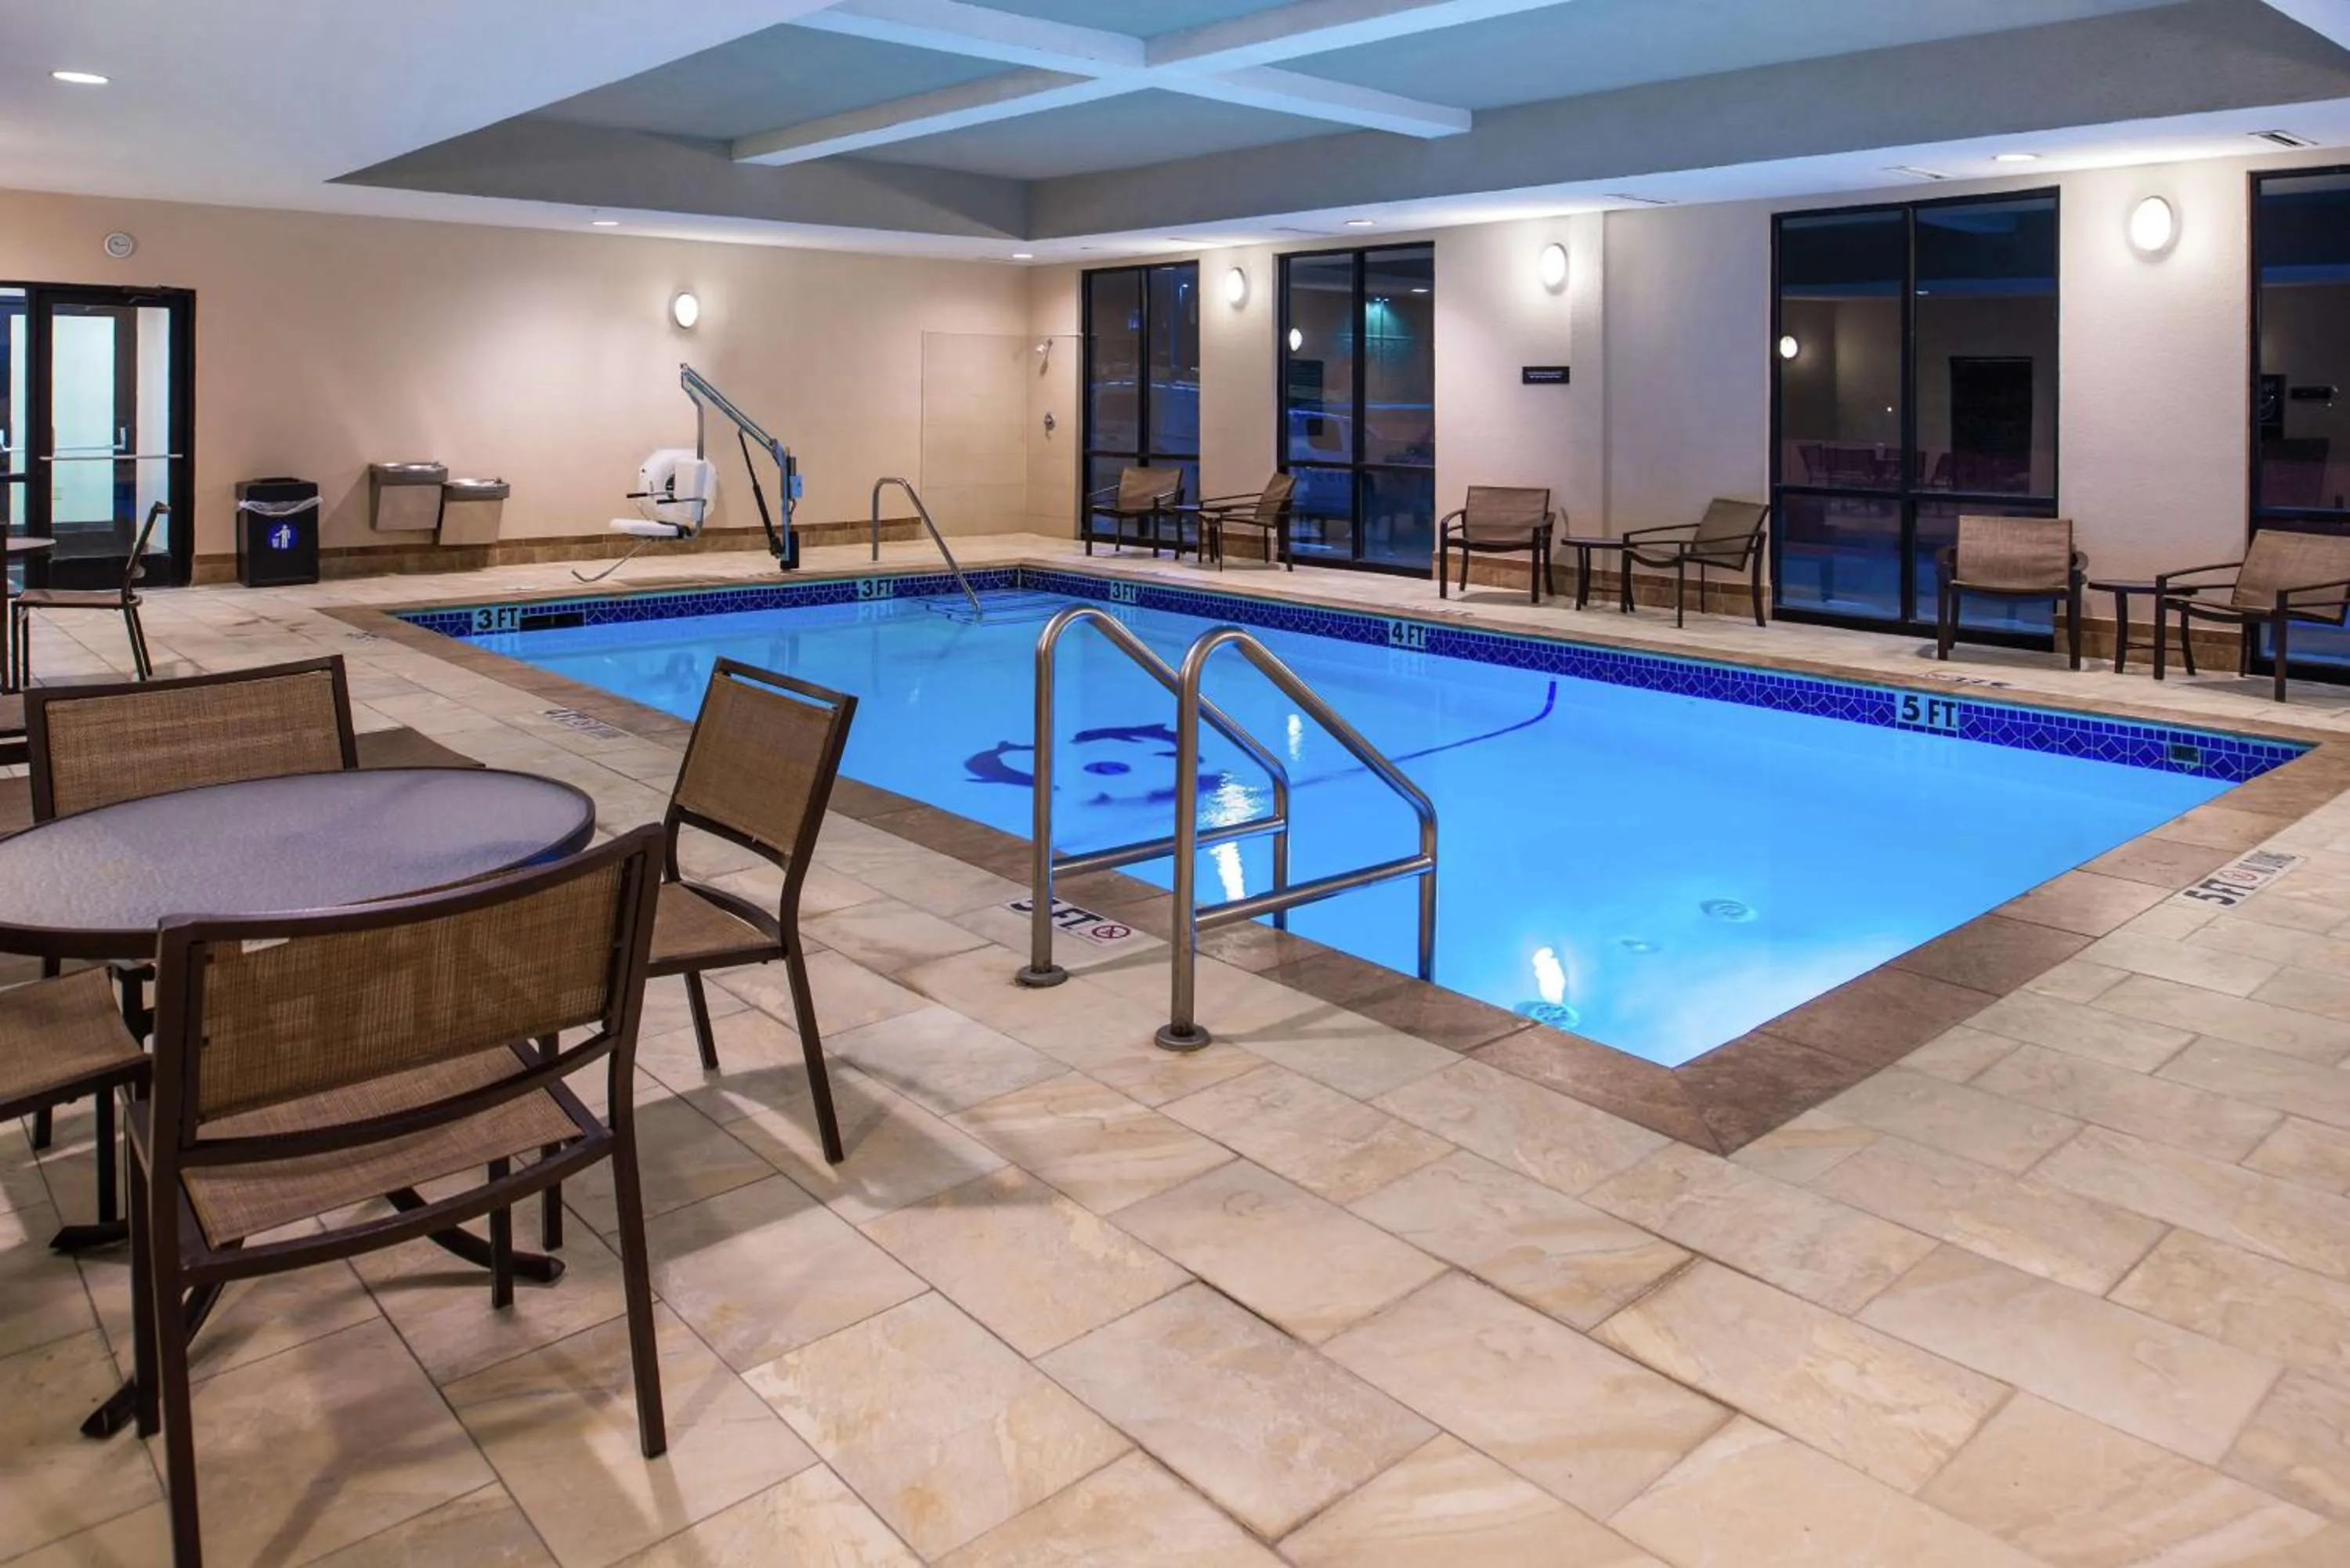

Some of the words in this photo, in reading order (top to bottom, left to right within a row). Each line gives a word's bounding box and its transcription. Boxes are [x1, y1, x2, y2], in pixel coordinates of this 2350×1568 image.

[862, 580, 873, 597] 3
[877, 579, 892, 596] FT
[1112, 582, 1121, 599] 3
[477, 609, 493, 630] 3
[497, 608, 518, 628] FT
[1392, 621, 1405, 643] 4
[1408, 624, 1425, 646] FT
[1902, 695, 1920, 721] 5
[2182, 889, 2237, 905] 5
